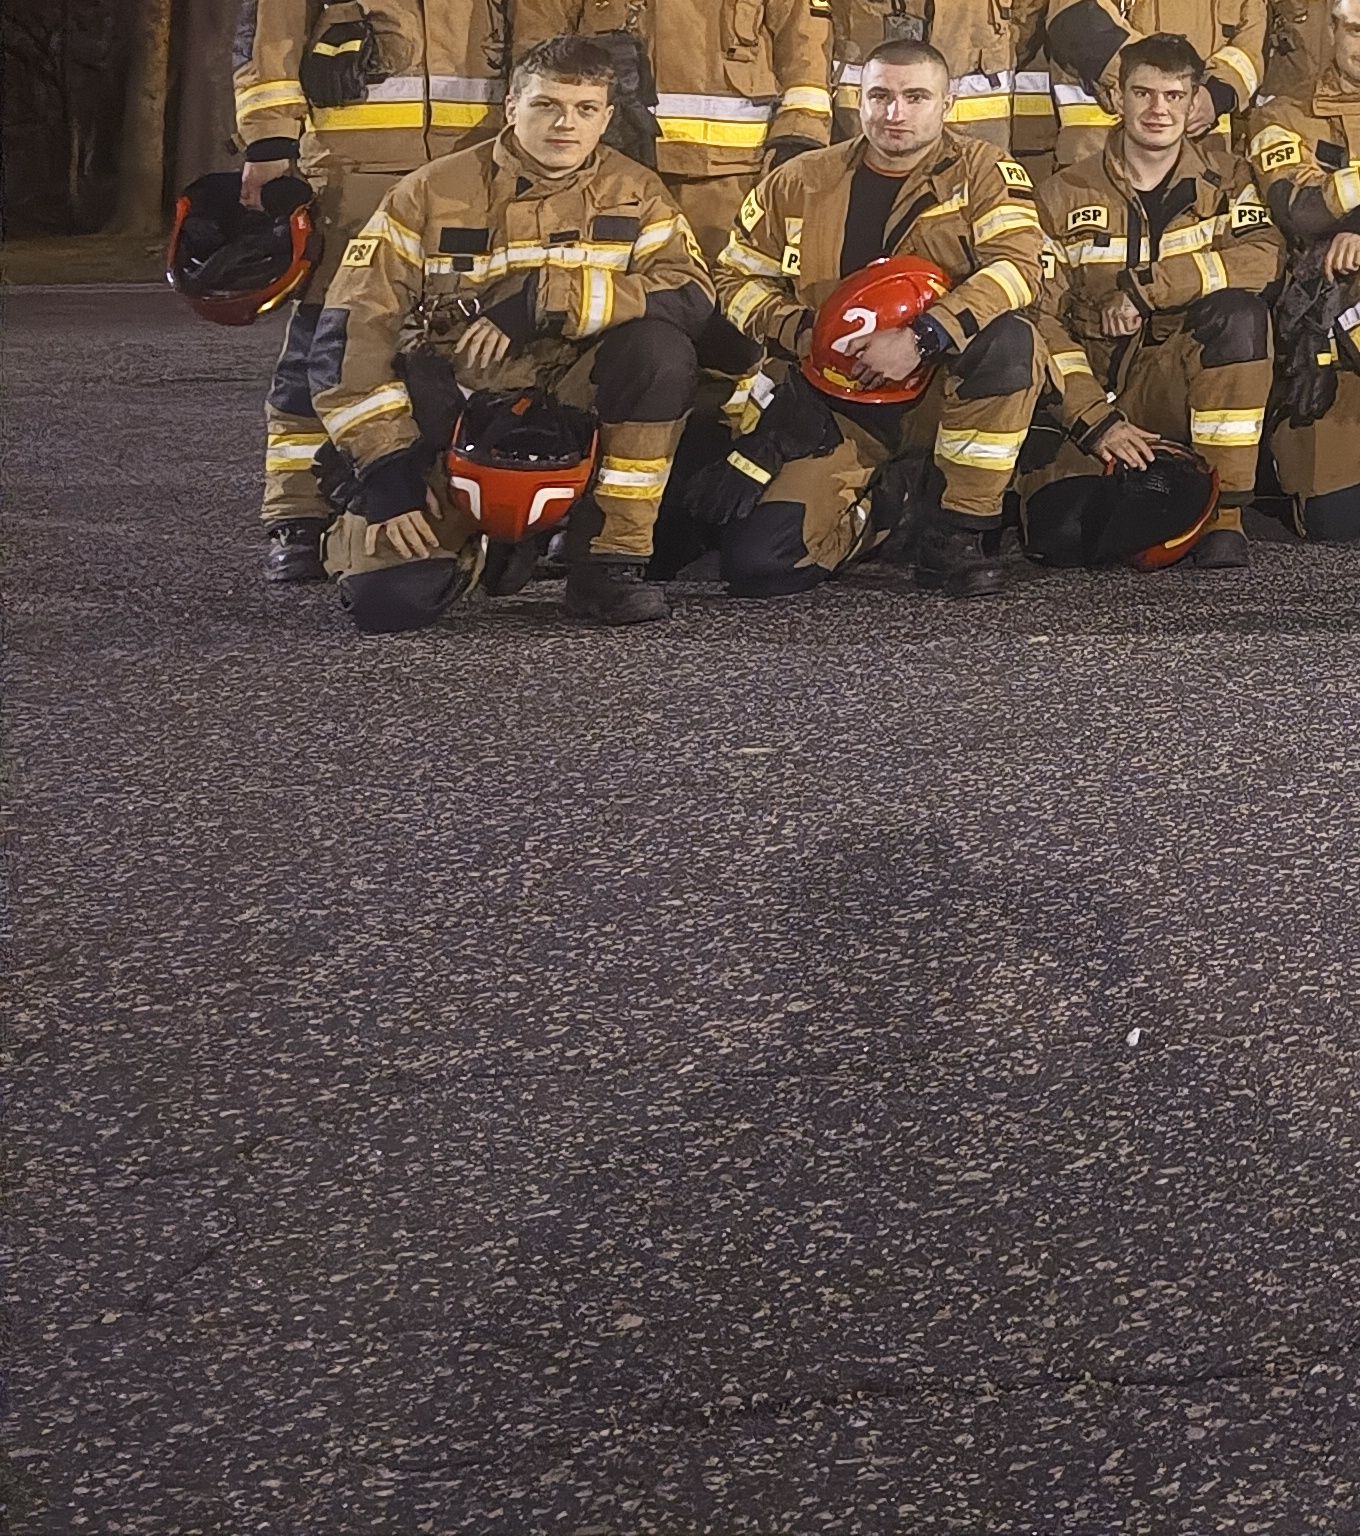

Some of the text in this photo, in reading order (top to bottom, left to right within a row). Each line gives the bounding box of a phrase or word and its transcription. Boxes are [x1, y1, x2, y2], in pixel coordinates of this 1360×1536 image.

[1266, 146, 1294, 166] PSP
[1072, 209, 1101, 224] PSP
[1238, 209, 1267, 223] PSP
[831, 307, 878, 354] 2
